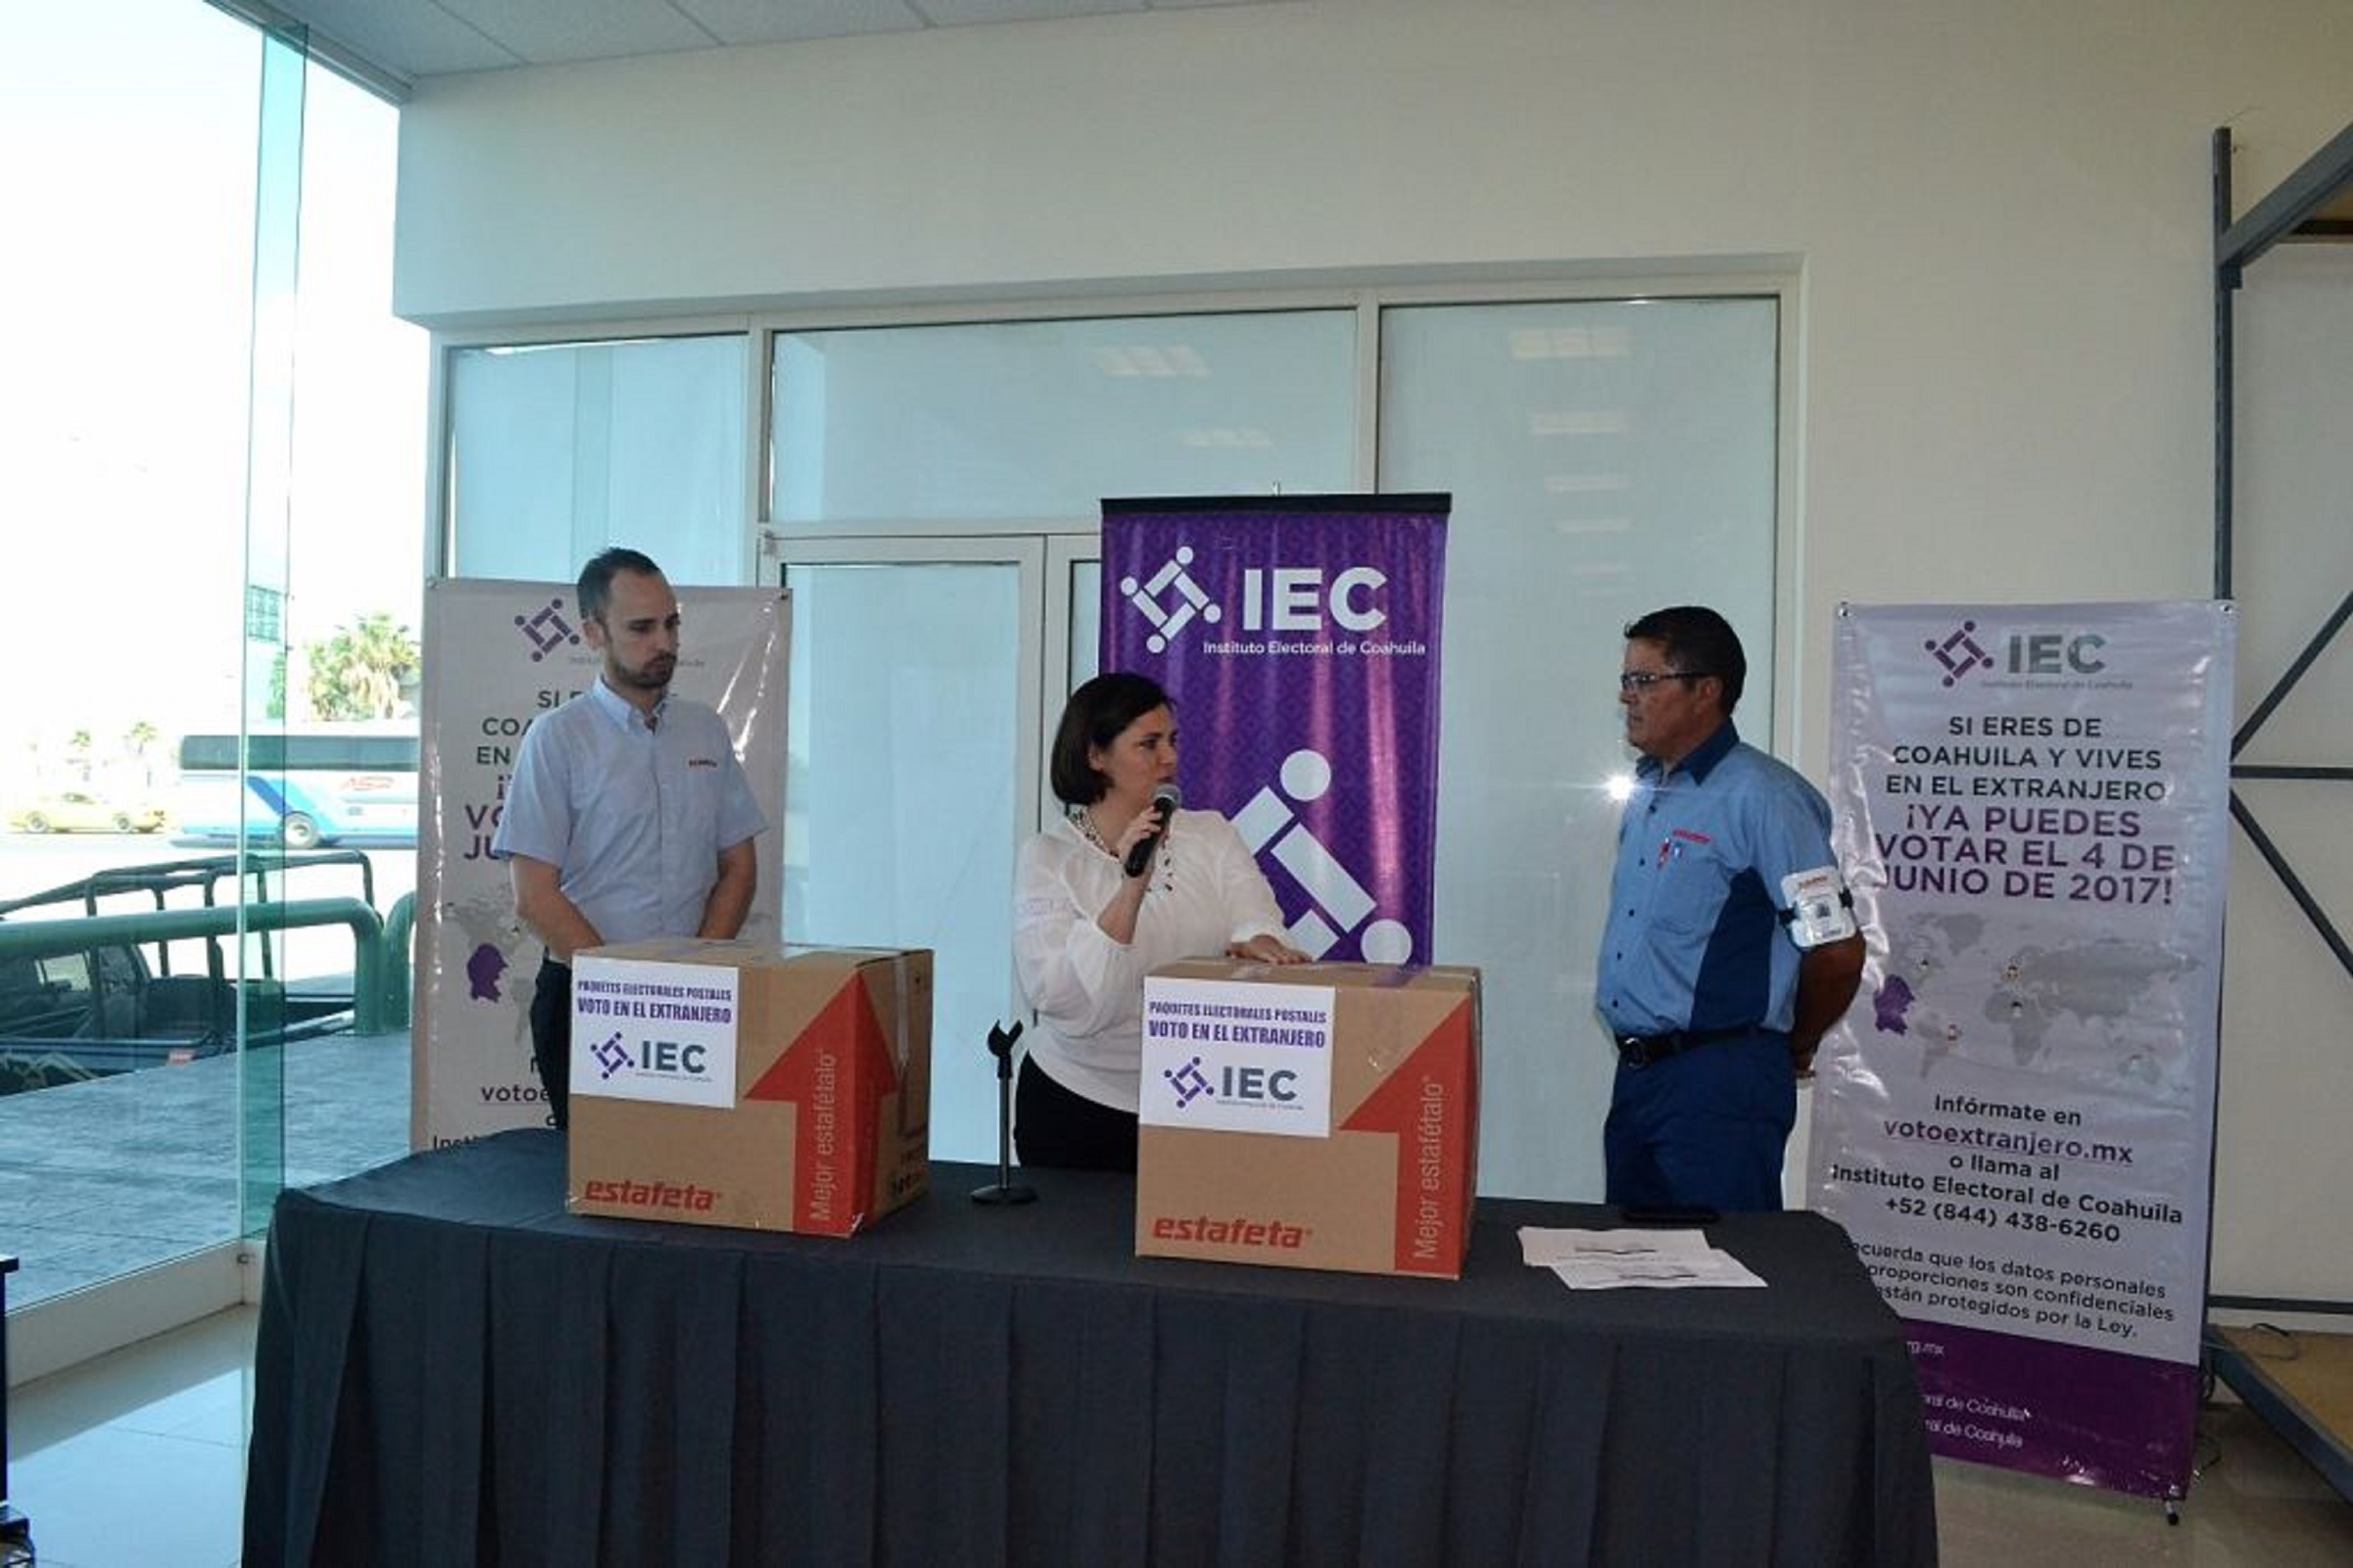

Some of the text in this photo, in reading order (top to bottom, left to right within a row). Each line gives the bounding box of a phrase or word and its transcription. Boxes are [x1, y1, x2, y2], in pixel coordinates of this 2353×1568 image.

[1242, 566, 1388, 632] IEC
[1203, 641, 1426, 655] Instituto Electoral de Coahuila
[2008, 633, 2106, 675] IEC
[1948, 716, 2102, 736] SI ERES DE
[476, 746, 511, 765] EN
[1893, 745, 2162, 770] COAHUILA Y VIVES
[1886, 775, 2167, 801] EN EL EXTRANJERO
[1906, 804, 2140, 837] ¡YA PUEDES
[1875, 833, 2175, 872] VOTAR EL 4 DE
[2004, 871, 2055, 898] DE
[2069, 874, 2172, 905] 2017!
[578, 998, 732, 1023] VOTO EN EL EXTRANJERO
[1274, 1009, 1326, 1023] POSTALES
[1149, 1020, 1326, 1048] VOTO EN EL EXTRANJERO
[642, 1040, 706, 1073] IEC
[1222, 1066, 1298, 1101] IEC
[1934, 1094, 2082, 1126] Infórmate en
[1884, 1120, 2134, 1164] votoextranjero.mx
[1949, 1155, 2060, 1181] o llama al
[585, 1178, 715, 1212] estafeta
[810, 1161, 838, 1221] Mejor
[1832, 1164, 2184, 1224] Instituto Electoral de Coahuila
[1152, 1216, 1304, 1250] estafeta
[1414, 1197, 1442, 1260] Mejor
[1886, 1197, 2121, 1243] +52 (844) 438-6260
[1849, 1242, 2166, 1299] ecuerda que los datos personales
[1927, 1291, 2031, 1320] protegidos
[2036, 1309, 2069, 1325] por
[2076, 1312, 2092, 1328] la
[2097, 1316, 2137, 1338] Ley.
[1995, 1283, 2028, 1298] son
[2033, 1288, 2175, 1322] confidenciales
